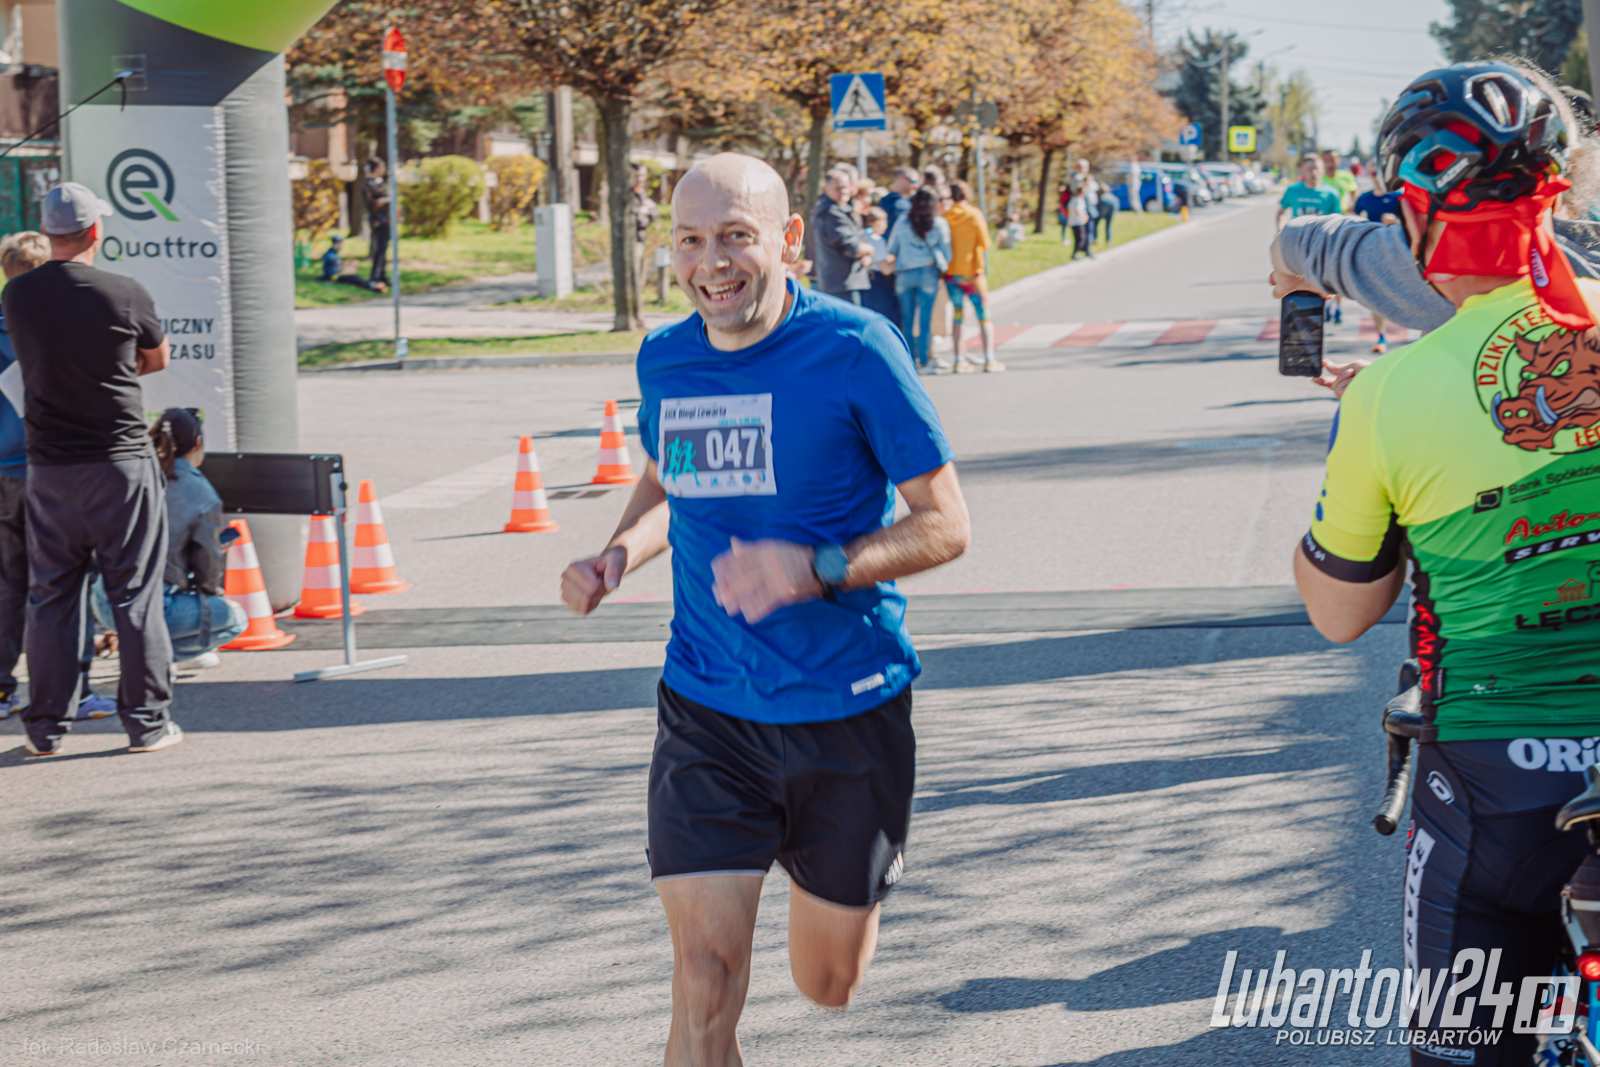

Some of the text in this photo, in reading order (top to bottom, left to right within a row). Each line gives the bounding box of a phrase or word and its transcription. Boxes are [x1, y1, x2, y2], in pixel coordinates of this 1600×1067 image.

[102, 236, 218, 262] Quattro
[160, 318, 215, 335] ICZNY
[169, 343, 215, 360] ZASU
[1477, 334, 1515, 386] DZIKI
[1507, 307, 1551, 332] TEA
[1574, 425, 1600, 448] ŁĘ
[705, 428, 760, 470] 047
[1509, 480, 1541, 495] Bank
[1507, 737, 1600, 772] ORi
